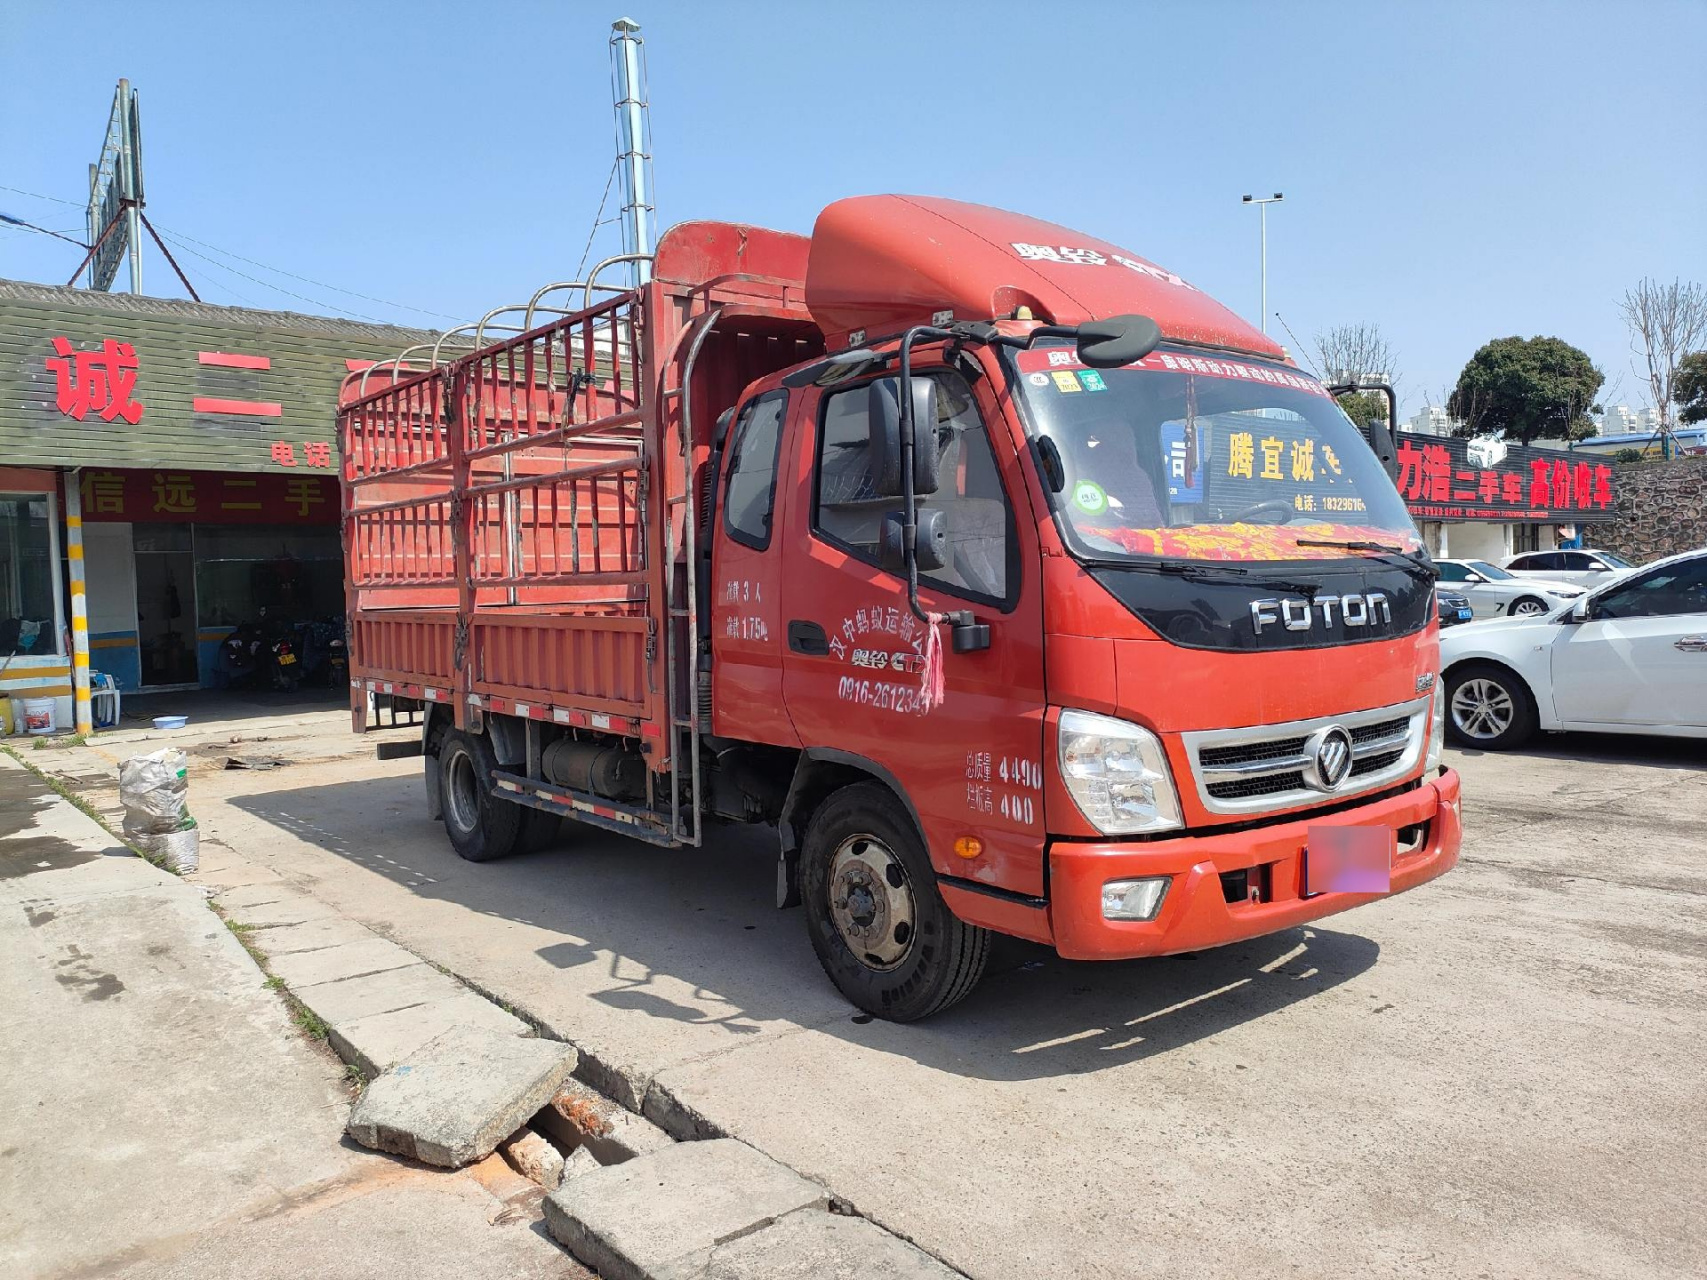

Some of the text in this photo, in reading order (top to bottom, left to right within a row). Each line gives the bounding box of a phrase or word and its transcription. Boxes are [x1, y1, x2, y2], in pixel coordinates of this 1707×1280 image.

[271, 441, 331, 467] 电话
[80, 471, 326, 516] 信远二手
[1530, 458, 1612, 510] 高价收车
[1250, 593, 1391, 634] FOTON
[851, 648, 888, 669] 奥铃
[999, 756, 1041, 790] 4490
[1001, 793, 1033, 824] 400
